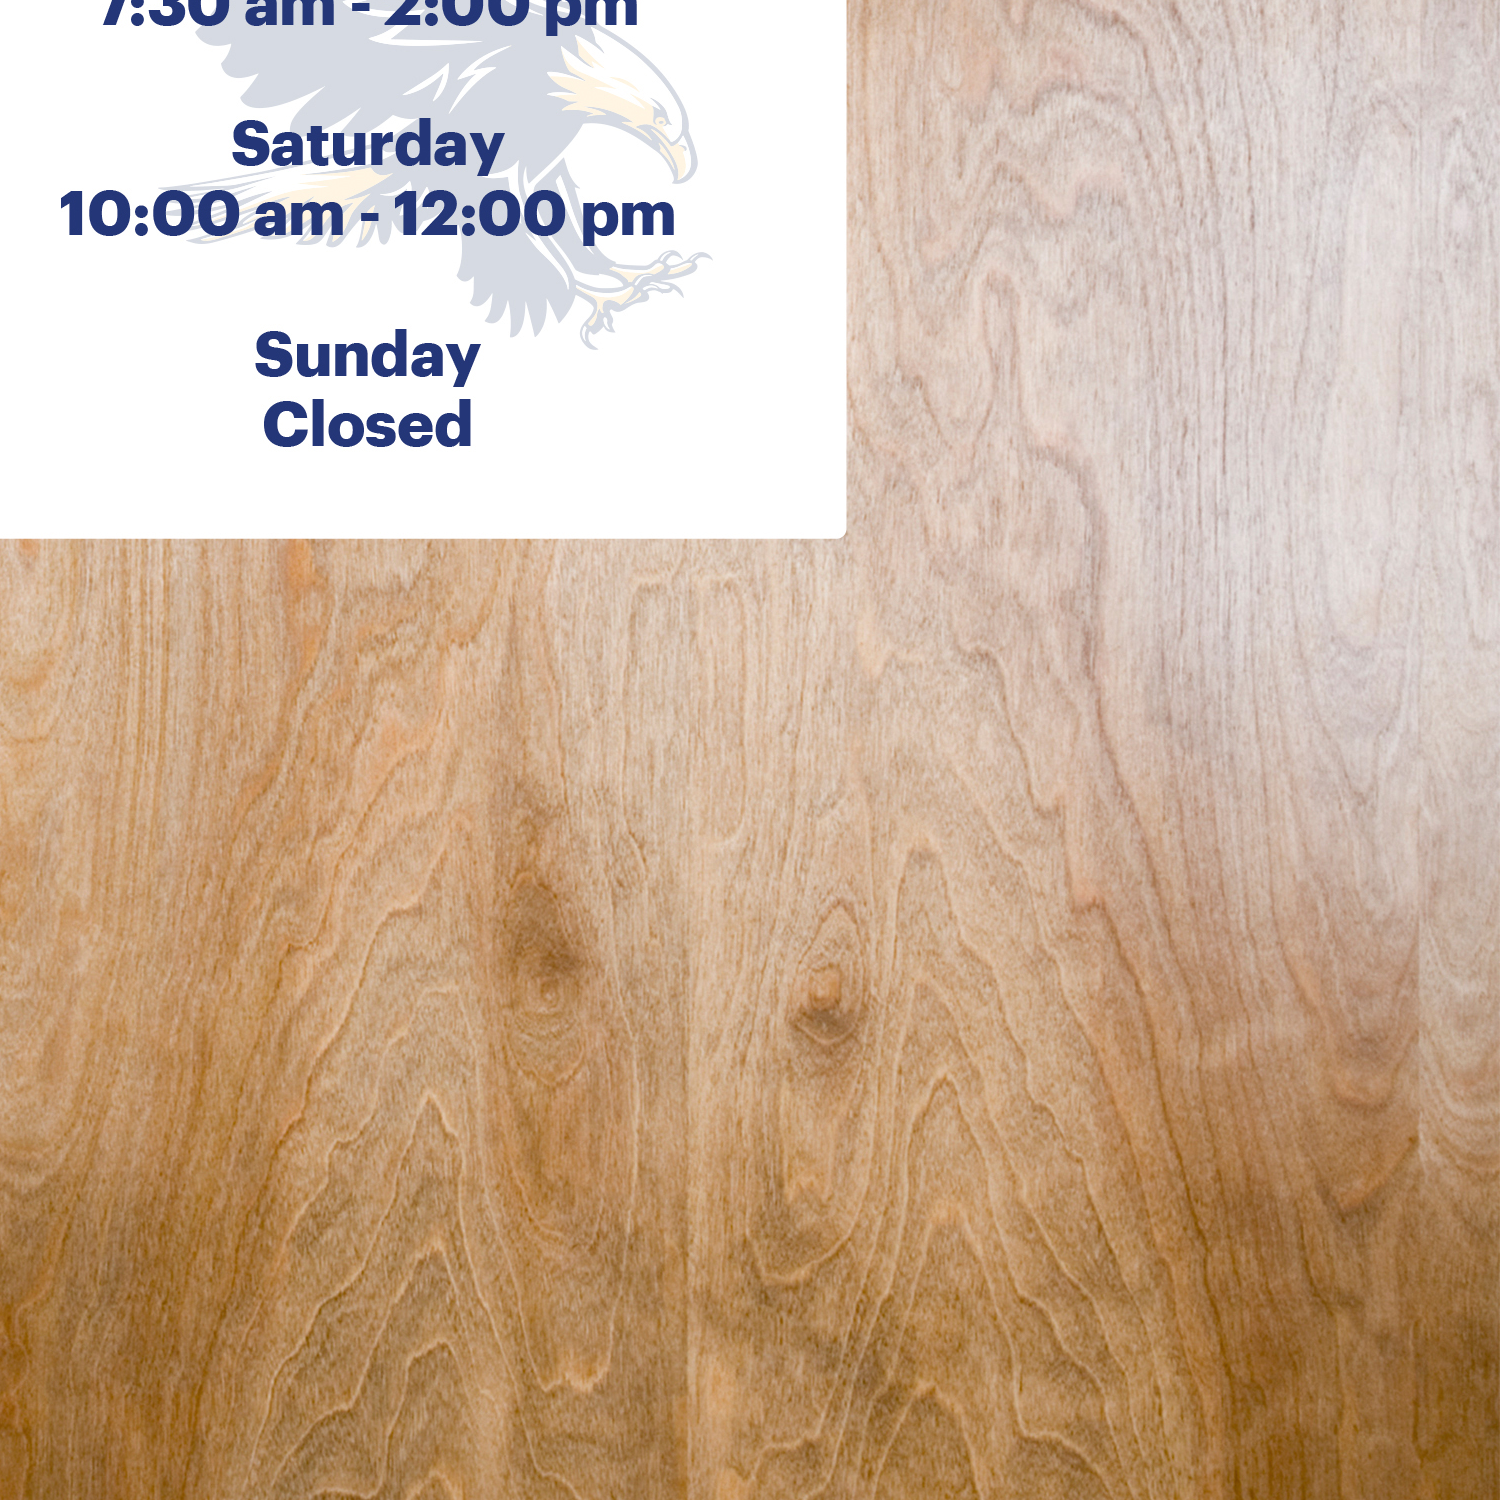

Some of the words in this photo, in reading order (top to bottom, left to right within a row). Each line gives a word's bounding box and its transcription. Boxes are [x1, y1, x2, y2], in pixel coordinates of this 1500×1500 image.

[232, 117, 506, 177] Saturday
[60, 189, 240, 237] 10:00
[254, 201, 344, 237] am
[394, 189, 566, 237] 12:00
[582, 201, 675, 247] pm
[255, 328, 482, 388] Sunday
[263, 398, 471, 448] Closed
